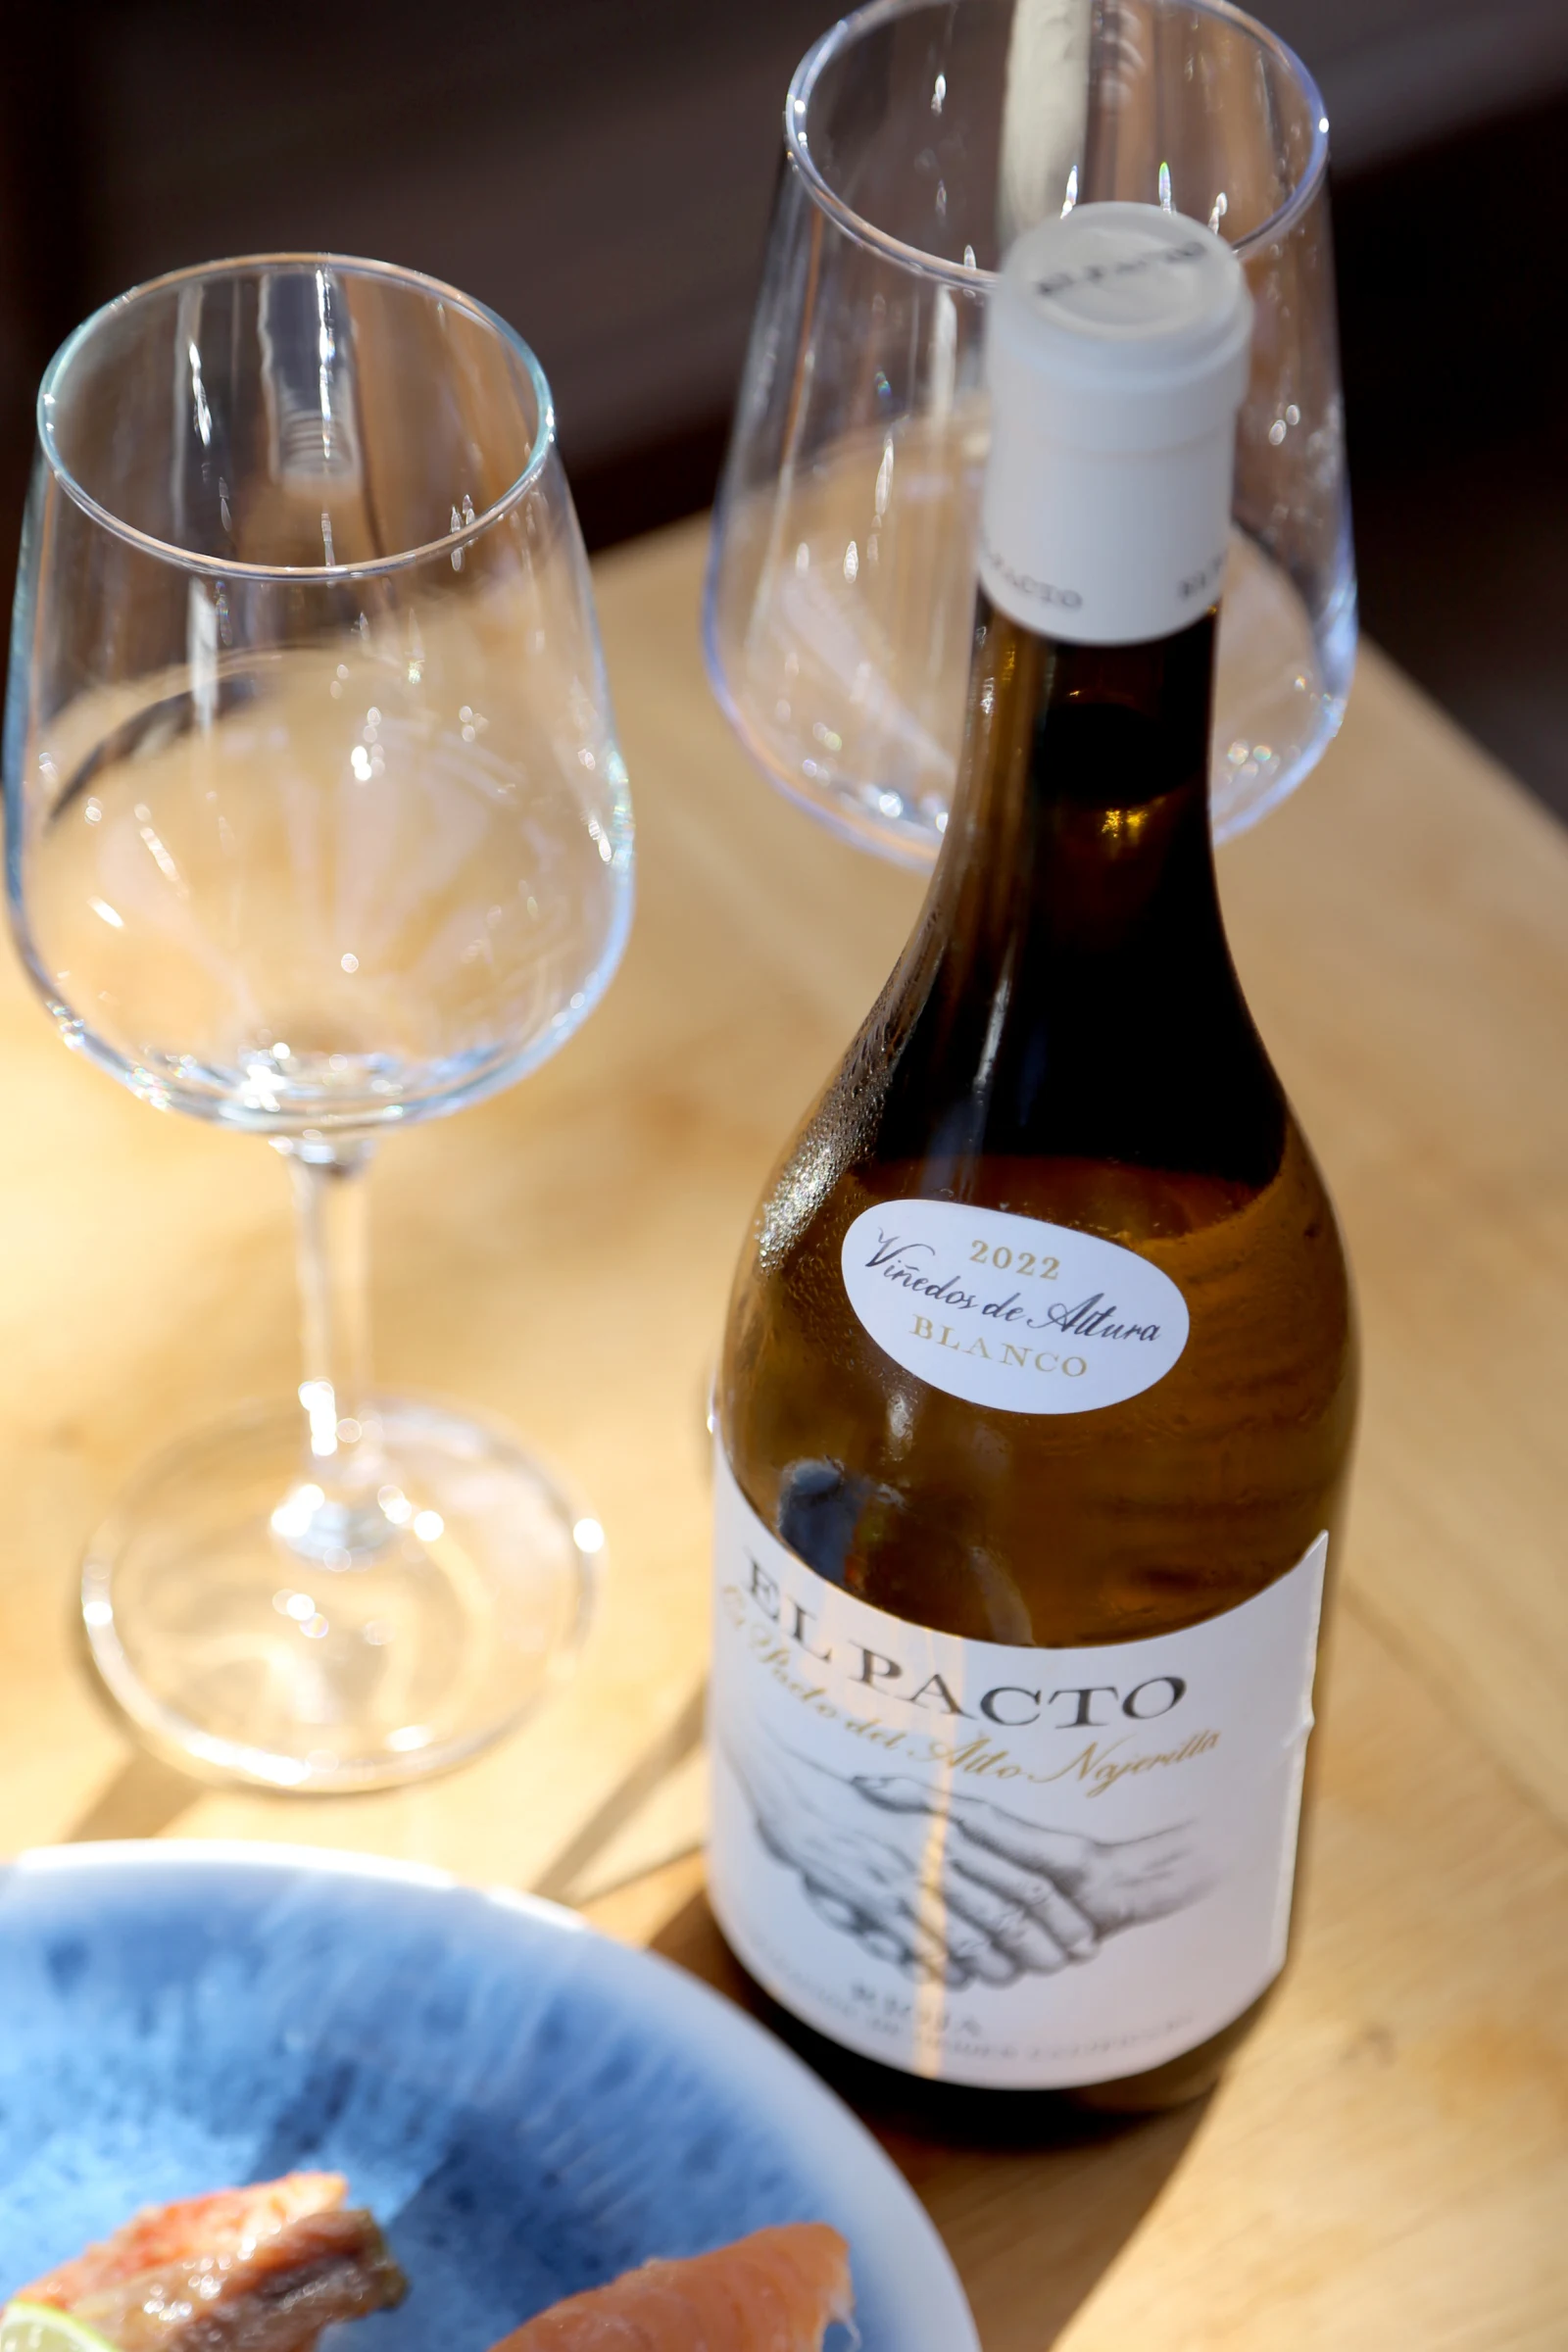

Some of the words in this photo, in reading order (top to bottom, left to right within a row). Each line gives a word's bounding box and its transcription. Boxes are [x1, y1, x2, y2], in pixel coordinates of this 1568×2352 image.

[864, 1226, 978, 1310] Viñedos
[981, 1292, 1025, 1322] de
[1026, 1292, 1161, 1343] Altura
[969, 1240, 1061, 1281] 2022
[909, 1314, 1088, 1377] BLANCO
[742, 1545, 834, 1664] EL
[848, 1639, 1187, 1730] PACTO
[844, 1717, 907, 1769] del
[907, 1735, 1022, 1780] Alto
